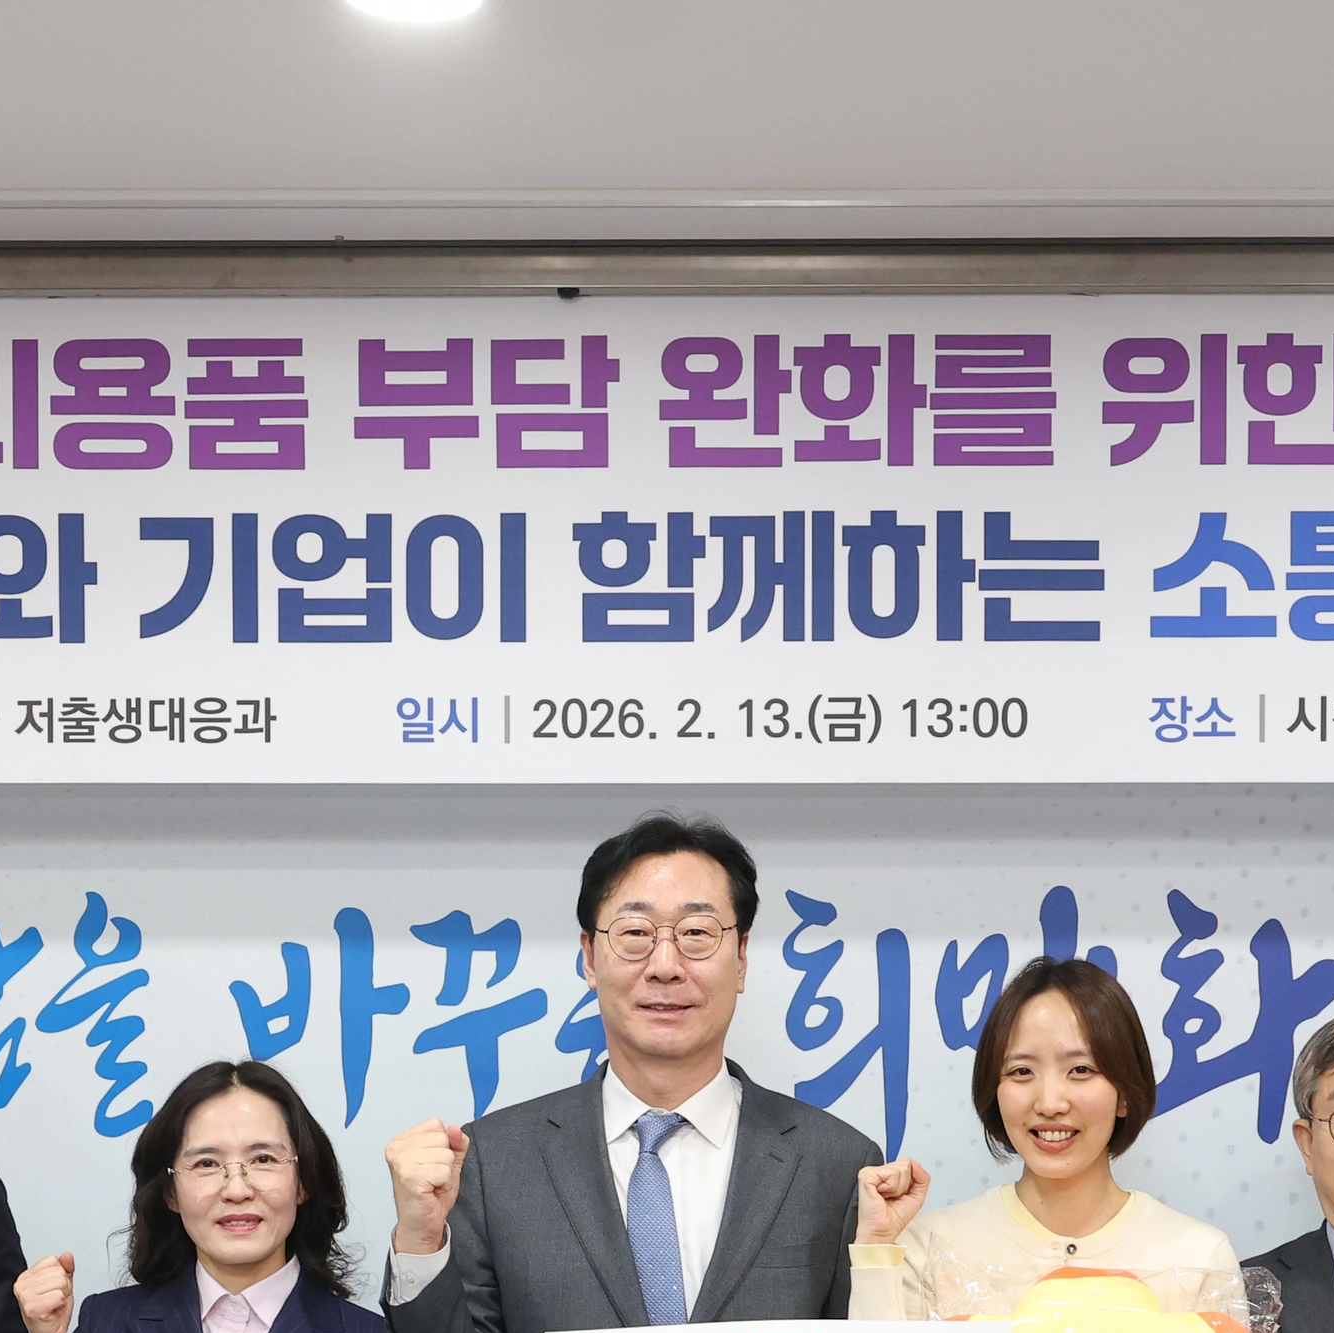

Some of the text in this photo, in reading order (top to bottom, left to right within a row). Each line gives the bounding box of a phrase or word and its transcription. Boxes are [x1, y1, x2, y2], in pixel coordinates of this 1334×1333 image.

[354, 335, 620, 469] 부담
[659, 334, 1056, 467] 완화를
[140, 513, 526, 643] 기업이
[573, 510, 1105, 642] 함께하는
[15, 697, 276, 743] 저출생대응과
[398, 694, 1027, 743] 일시 2026. 2. 13.(금) 13:00
[1150, 697, 1235, 742] 장소
[229, 904, 609, 1128] 바꾸
